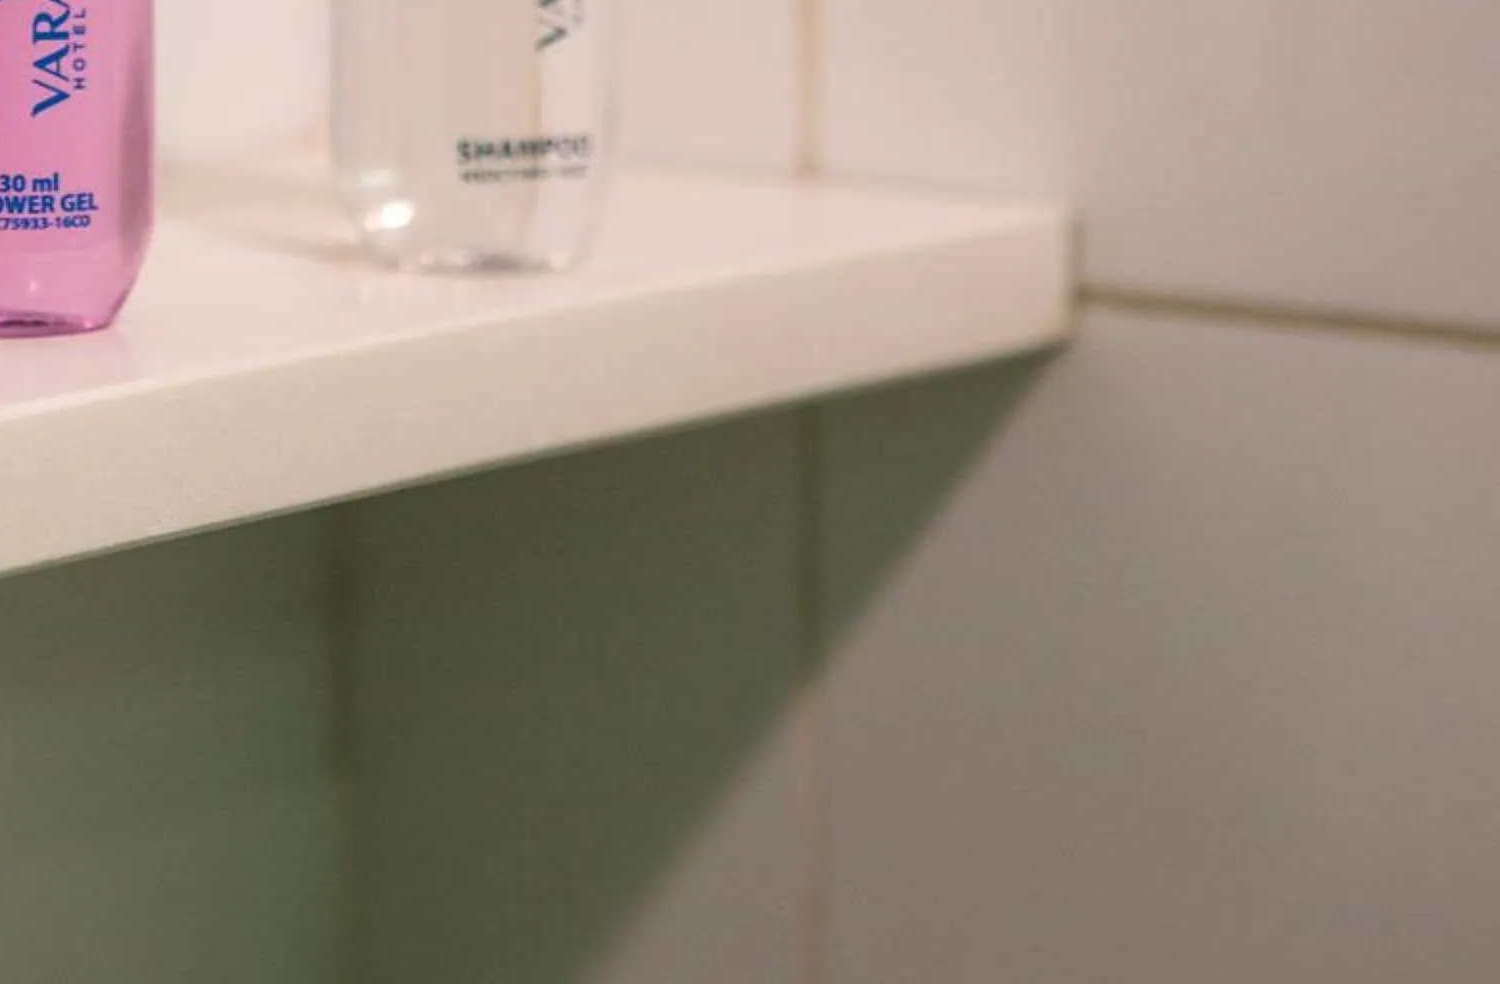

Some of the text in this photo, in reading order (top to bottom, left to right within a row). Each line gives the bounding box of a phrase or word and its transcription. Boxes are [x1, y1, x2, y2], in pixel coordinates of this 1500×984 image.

[72, 7, 88, 90] HOTEL
[31, 171, 60, 192] ml
[60, 192, 99, 212] GEL
